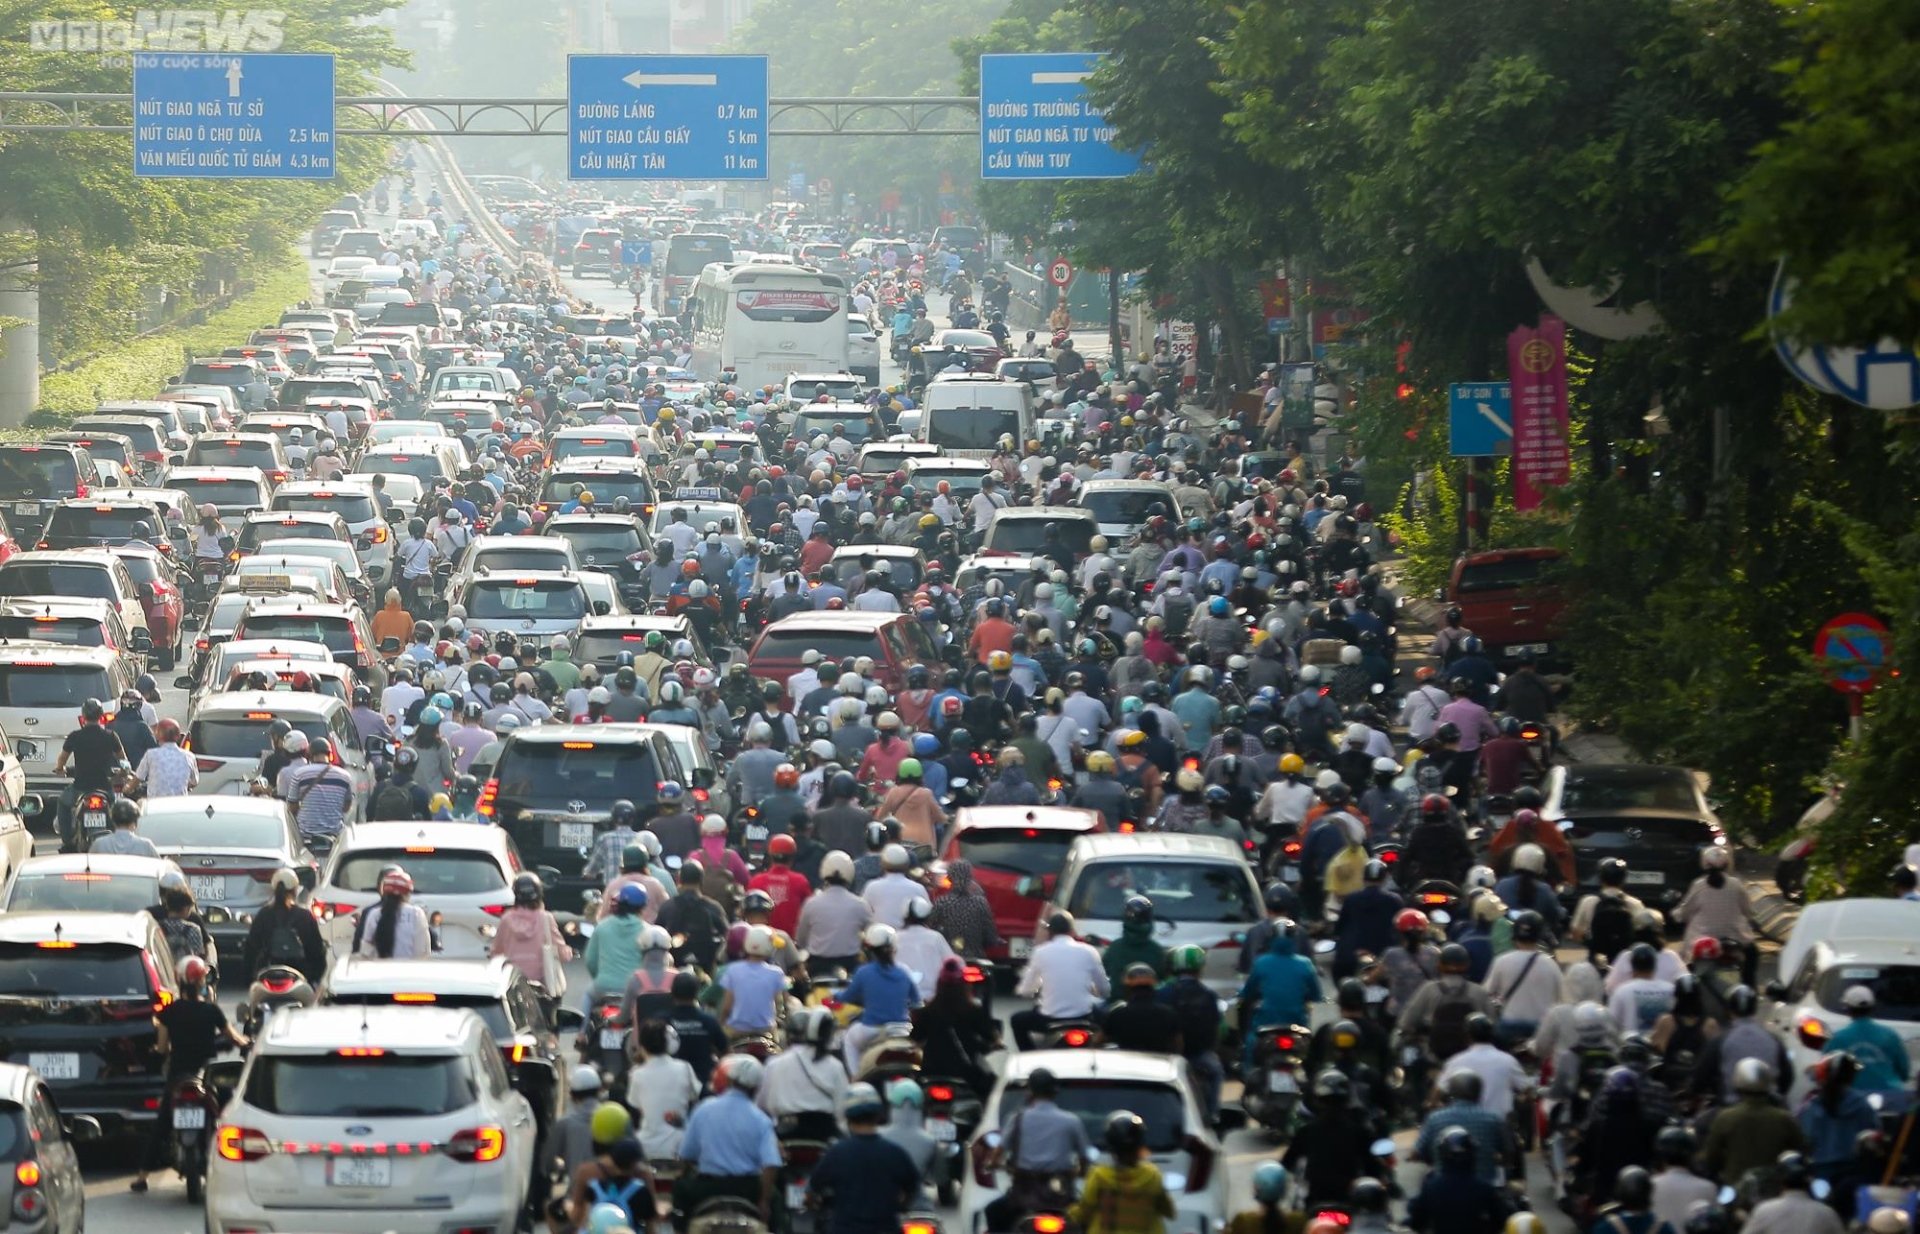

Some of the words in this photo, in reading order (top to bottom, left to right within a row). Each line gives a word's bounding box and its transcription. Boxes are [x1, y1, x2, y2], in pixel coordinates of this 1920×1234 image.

[140, 98, 162, 116] NÚT
[166, 101, 192, 116] GIAO
[198, 99, 222, 116] NGÃ
[227, 101, 242, 116] TƯ
[578, 100, 620, 118] ĐƯỜNG
[624, 100, 655, 118] LÁNG
[739, 104, 758, 118] km
[988, 99, 1028, 118] ĐƯỜNG
[1033, 98, 1080, 116] TRƯỜNG
[140, 124, 162, 141] NÚT
[166, 126, 192, 141] GIAO
[198, 124, 205, 141] Ô
[210, 126, 234, 144] CHỢ
[238, 124, 262, 142] DỪA
[312, 129, 329, 142] km
[580, 126, 602, 144] NÚT
[606, 130, 632, 144] GIAO
[638, 126, 660, 144] CẦU
[664, 125, 690, 144] GIẤY
[728, 130, 735, 144] 5
[739, 130, 758, 144] km
[988, 124, 1012, 143] NÚT
[1015, 128, 1041, 142] GIAO
[1045, 125, 1069, 142] NGÃ
[1073, 127, 1088, 142] TƯ
[140, 149, 162, 166] VĂN
[166, 148, 195, 166] MIẾU
[198, 148, 229, 167] QUỐC
[252, 150, 280, 168] GIÁM
[312, 154, 329, 168] km
[580, 151, 602, 168] CẦU
[606, 152, 637, 171] NHẬT
[643, 153, 665, 168] TÂN
[724, 155, 735, 168] 11
[739, 154, 758, 168] km
[988, 150, 1011, 168] CẦU
[1016, 151, 1044, 168] VĨNH
[1049, 154, 1072, 168] TUY
[1055, 266, 1064, 278] 30
